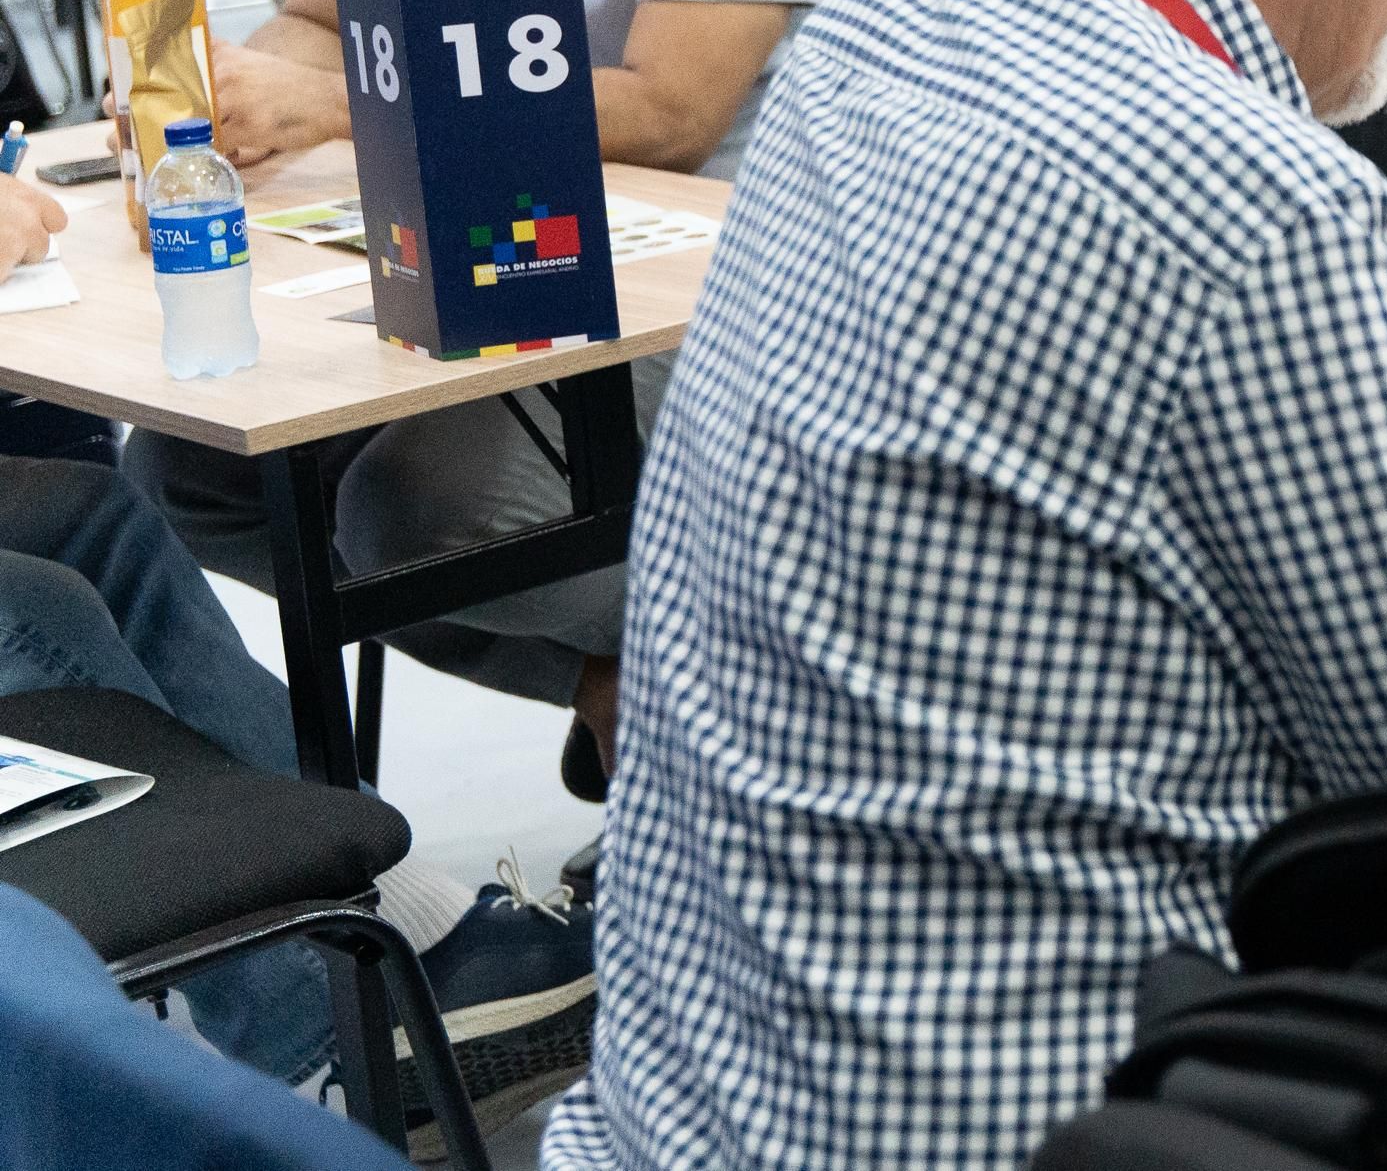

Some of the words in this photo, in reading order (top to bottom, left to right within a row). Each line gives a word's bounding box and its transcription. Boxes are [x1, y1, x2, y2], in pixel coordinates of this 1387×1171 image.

[350, 20, 400, 103] 18
[441, 13, 570, 98] 18
[513, 262, 526, 271] DE
[528, 256, 579, 270] NEGOCIOS
